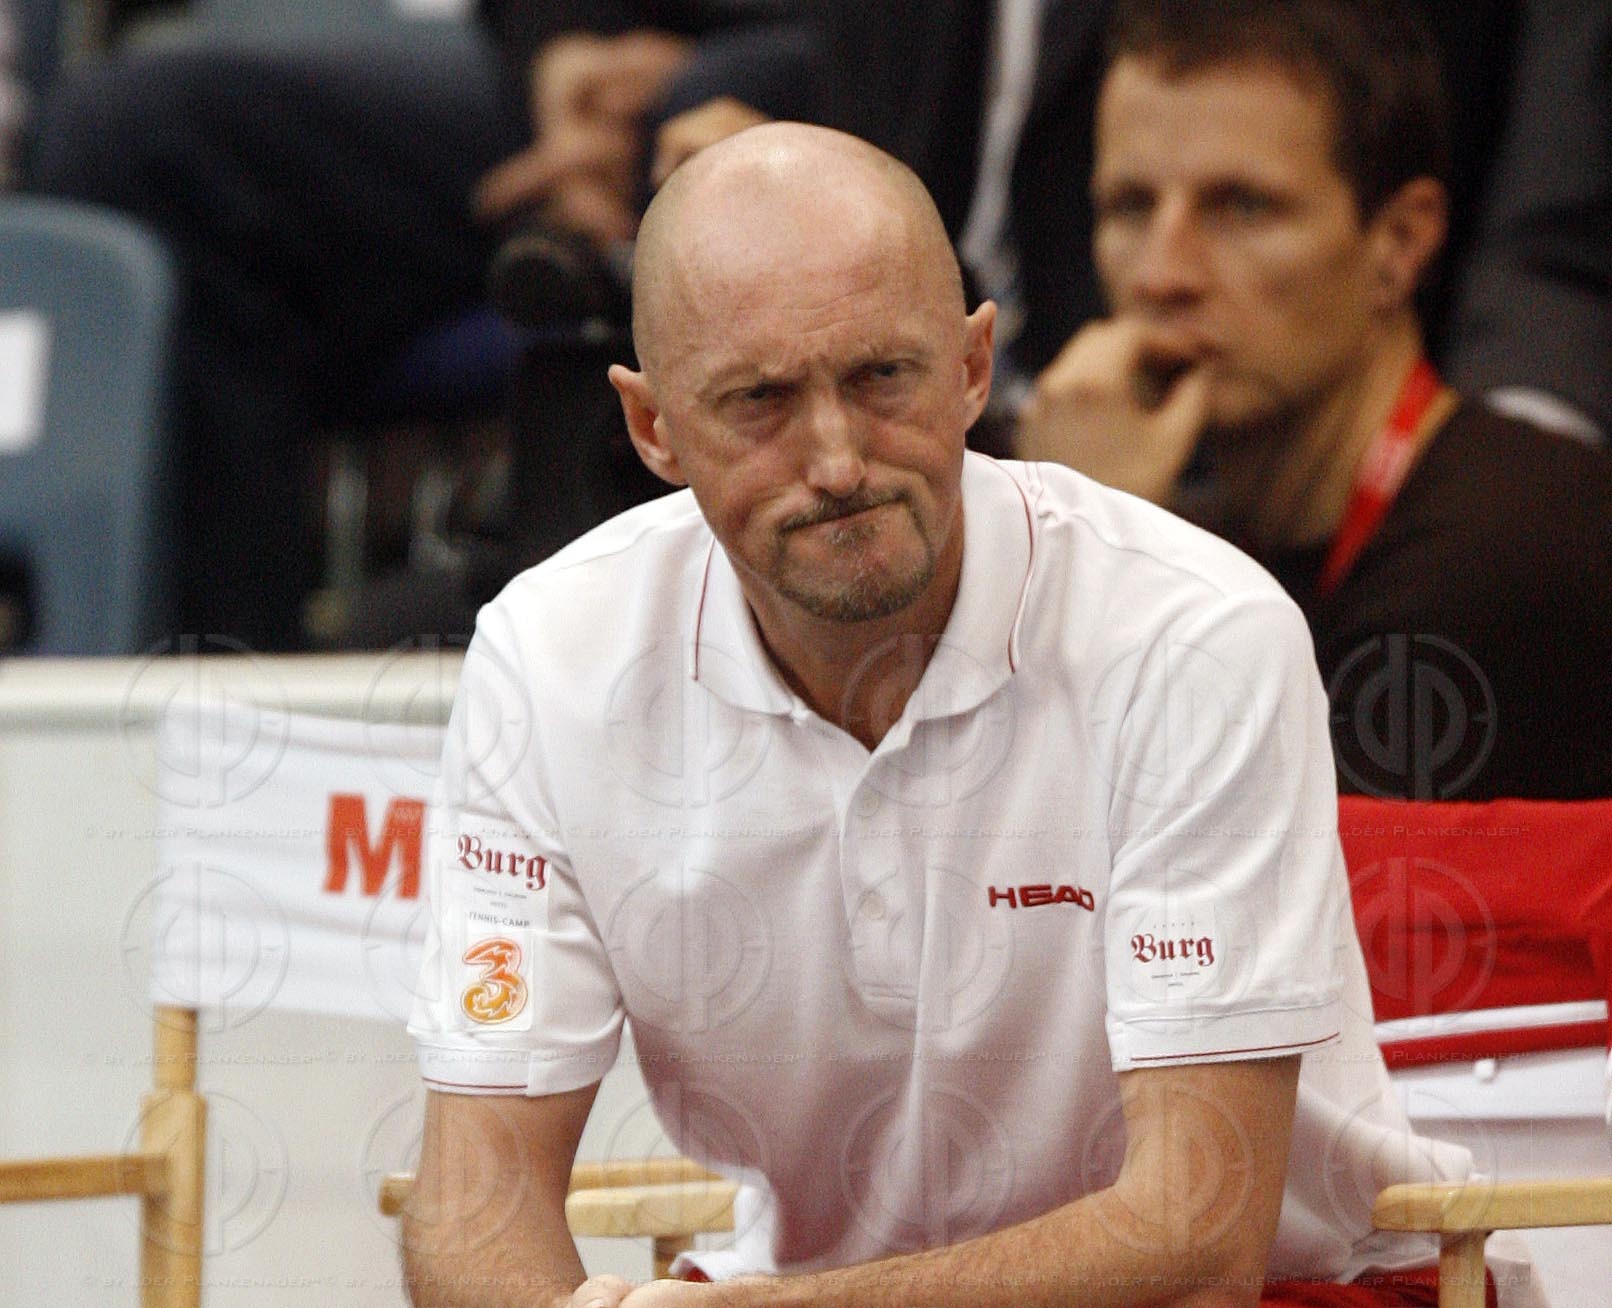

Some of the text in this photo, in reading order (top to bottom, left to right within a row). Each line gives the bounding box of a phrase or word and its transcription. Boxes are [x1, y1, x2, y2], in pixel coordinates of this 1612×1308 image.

[457, 834, 549, 891] Burg
[988, 884, 1095, 912] HEAD
[1131, 933, 1215, 967] Burg
